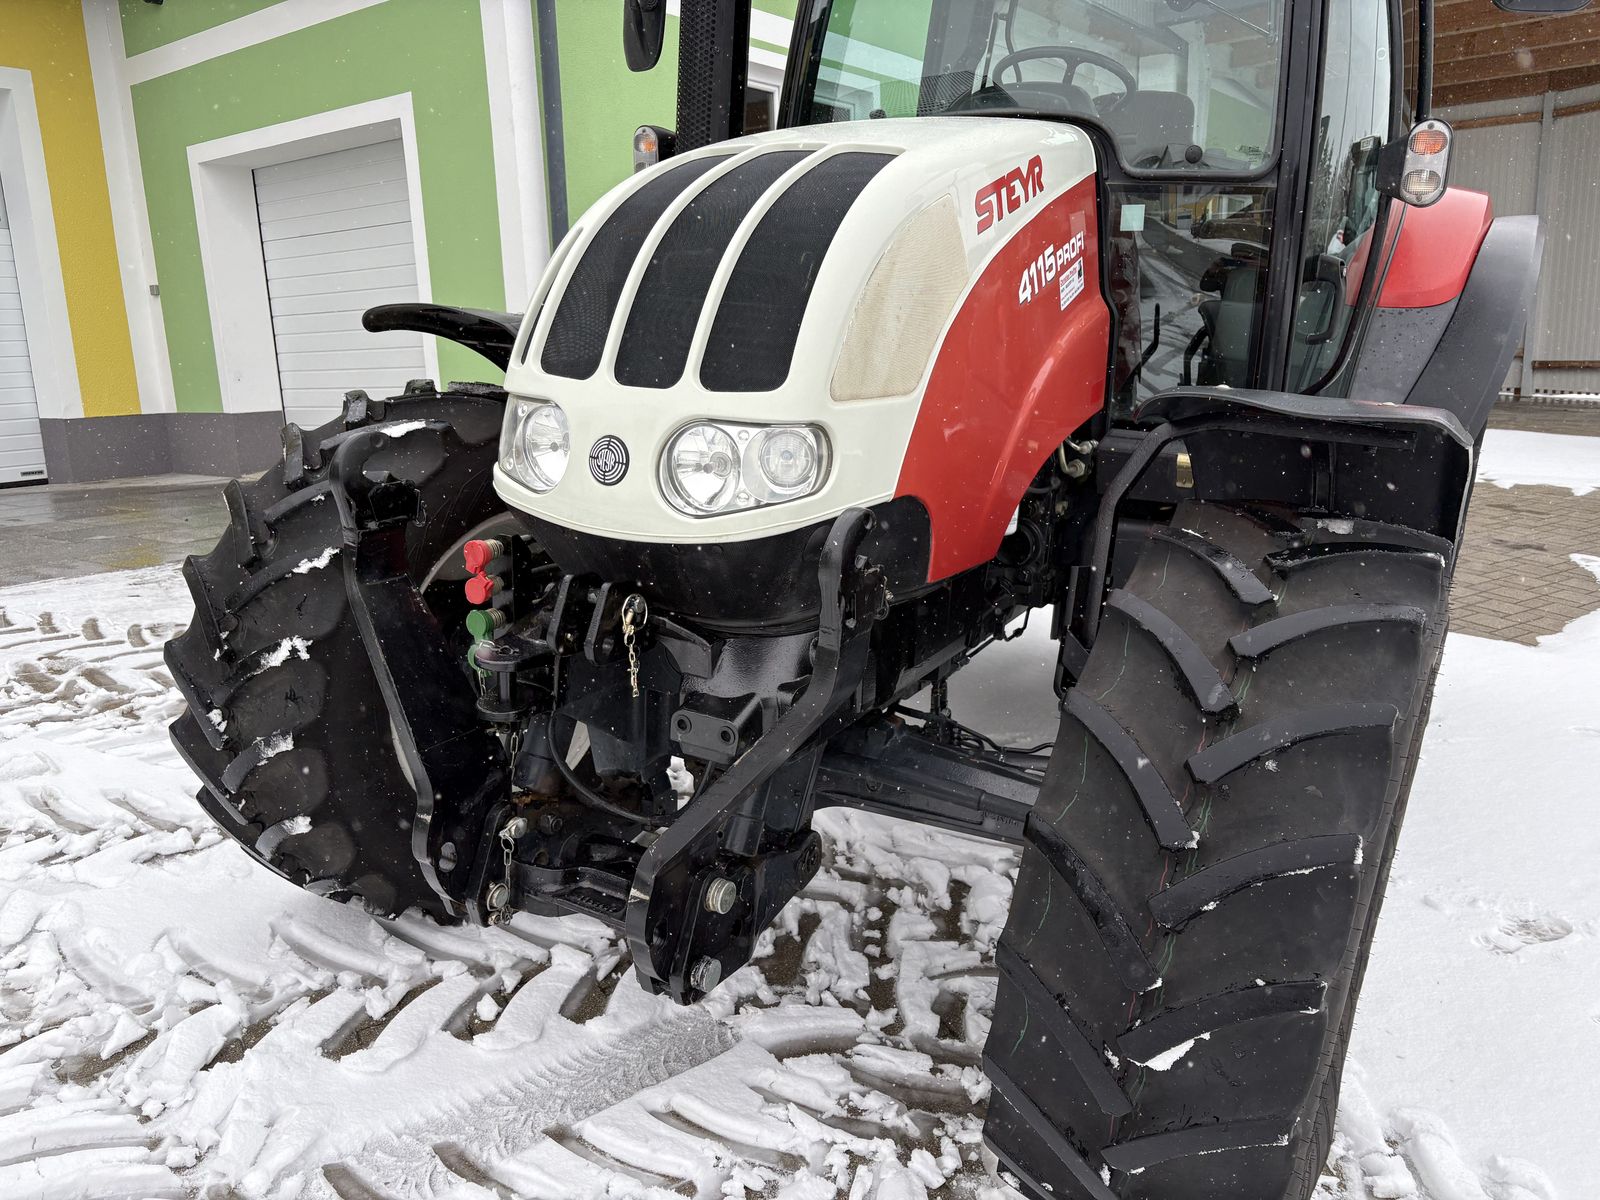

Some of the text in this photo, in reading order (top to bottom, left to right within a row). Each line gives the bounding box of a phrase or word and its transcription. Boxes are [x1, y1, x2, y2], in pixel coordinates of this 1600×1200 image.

[975, 155, 1044, 235] STEYR
[1018, 244, 1057, 304] 4115
[1056, 230, 1085, 271] PROFI
